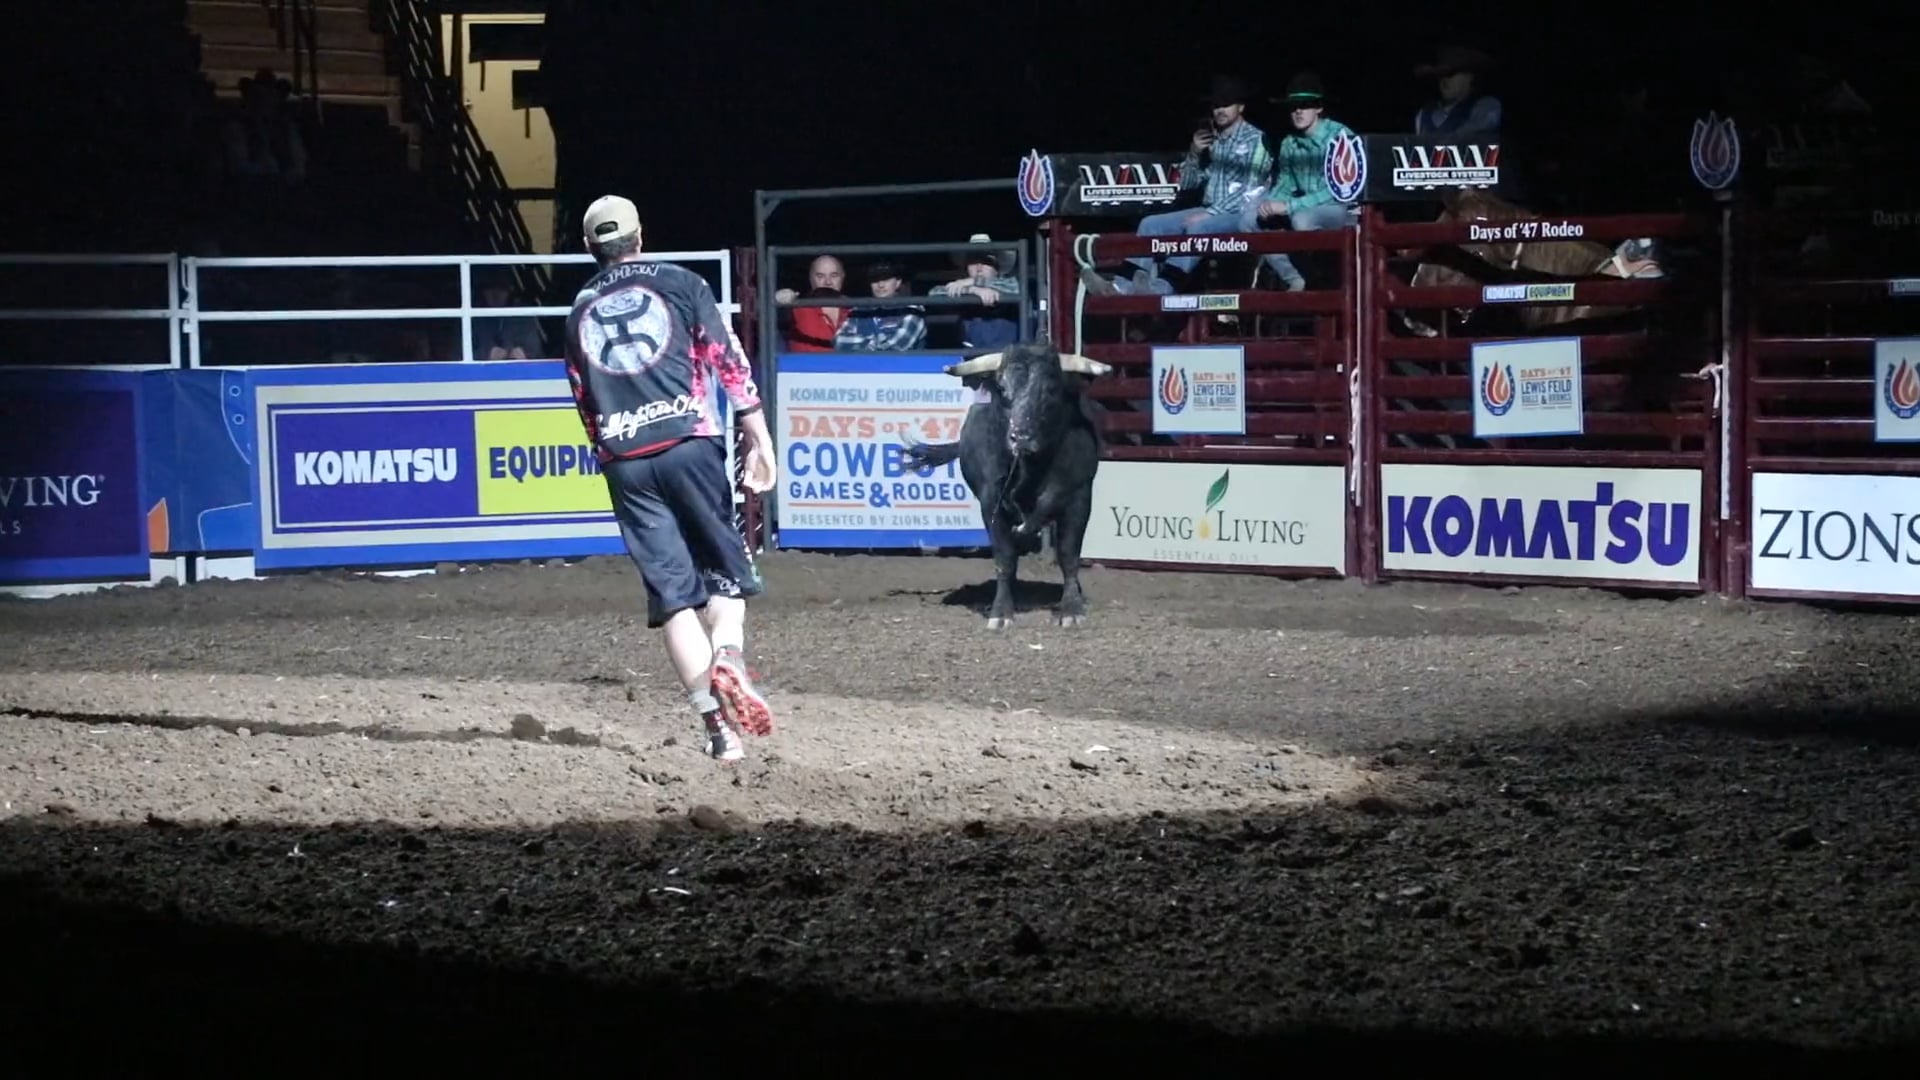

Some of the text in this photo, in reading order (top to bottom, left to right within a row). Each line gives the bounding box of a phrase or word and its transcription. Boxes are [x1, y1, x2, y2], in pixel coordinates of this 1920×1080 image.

[1470, 224, 1501, 243] Days
[1504, 222, 1518, 239] of
[1541, 220, 1584, 237] Rodeo
[1152, 238, 1178, 255] Days
[1180, 237, 1193, 252] of
[1212, 236, 1249, 252] Rodeo
[789, 388, 962, 404] KOMATSU EQUIPMENT
[1193, 384, 1215, 396] LEWIS
[1521, 379, 1572, 394] LEWIS FEILD
[789, 415, 876, 439] DAYS
[914, 416, 961, 440] '47
[294, 448, 457, 486] KOMATSU
[789, 481, 967, 508] GAMES & RODEO
[791, 514, 971, 527] PRESENTED BY ZIONS BANK
[1387, 482, 1690, 566] KOMATSU
